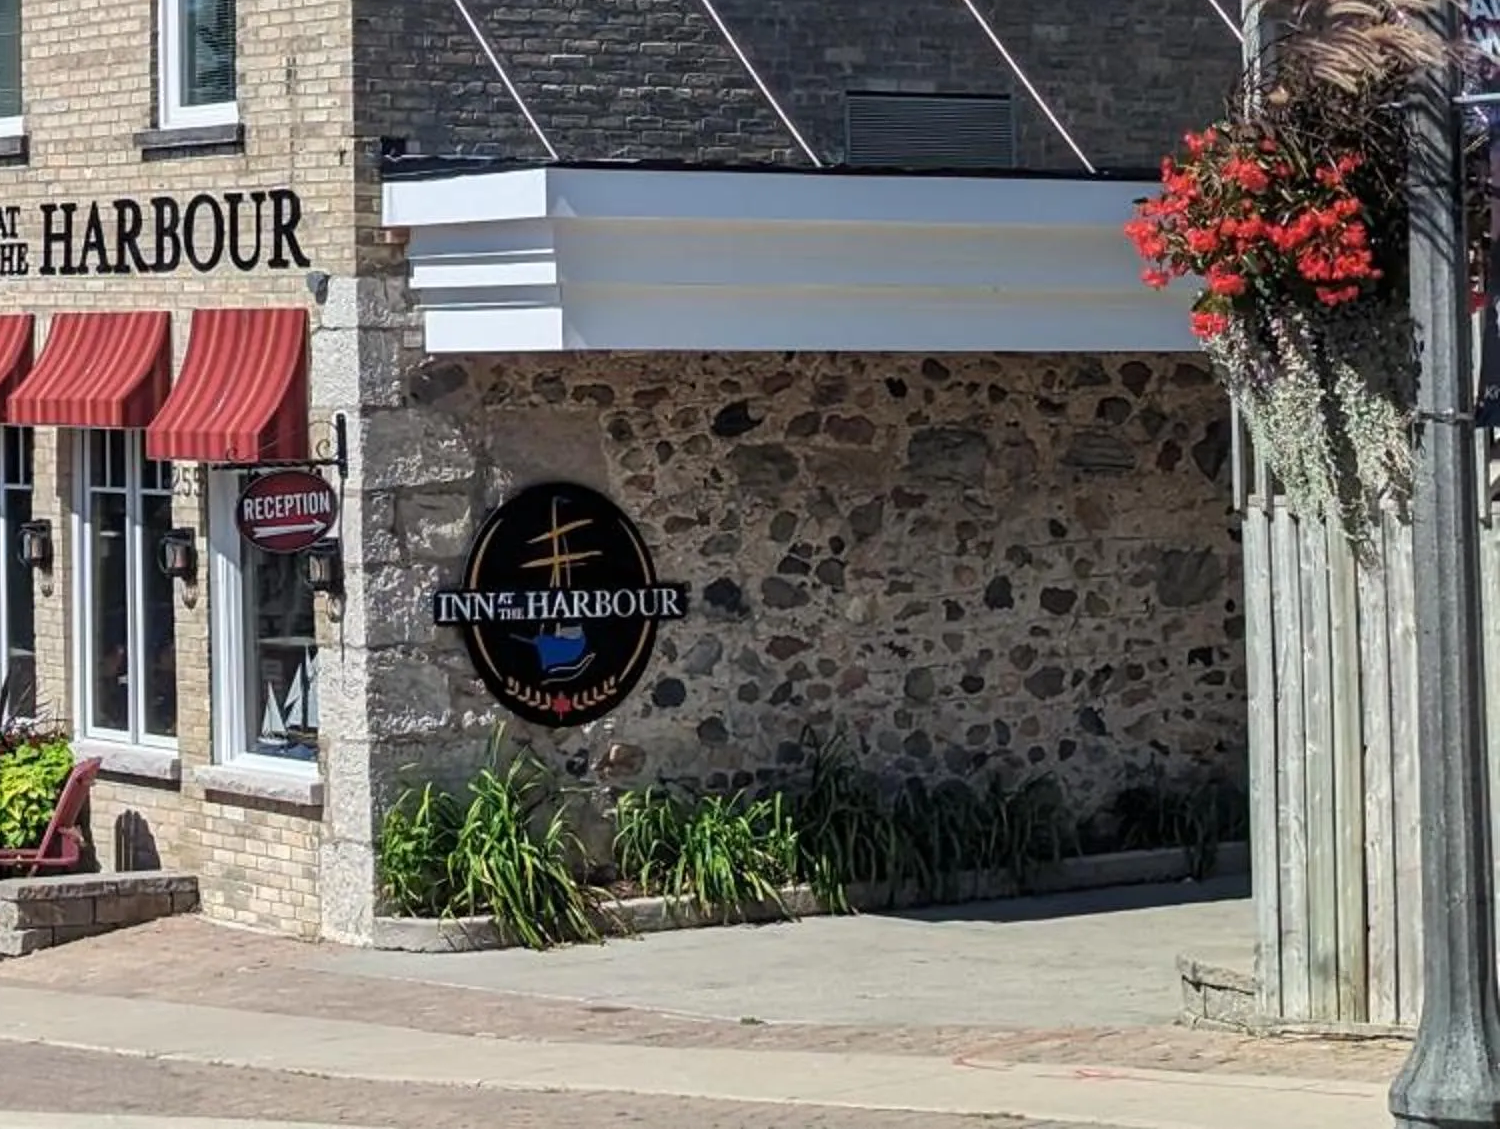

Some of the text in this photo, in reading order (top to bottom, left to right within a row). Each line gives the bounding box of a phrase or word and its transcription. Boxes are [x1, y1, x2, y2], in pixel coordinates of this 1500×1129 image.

[39, 188, 311, 276] HARBOUR
[243, 490, 331, 522] RECEPTION
[437, 588, 682, 621] INN AT THE HARBOUR
